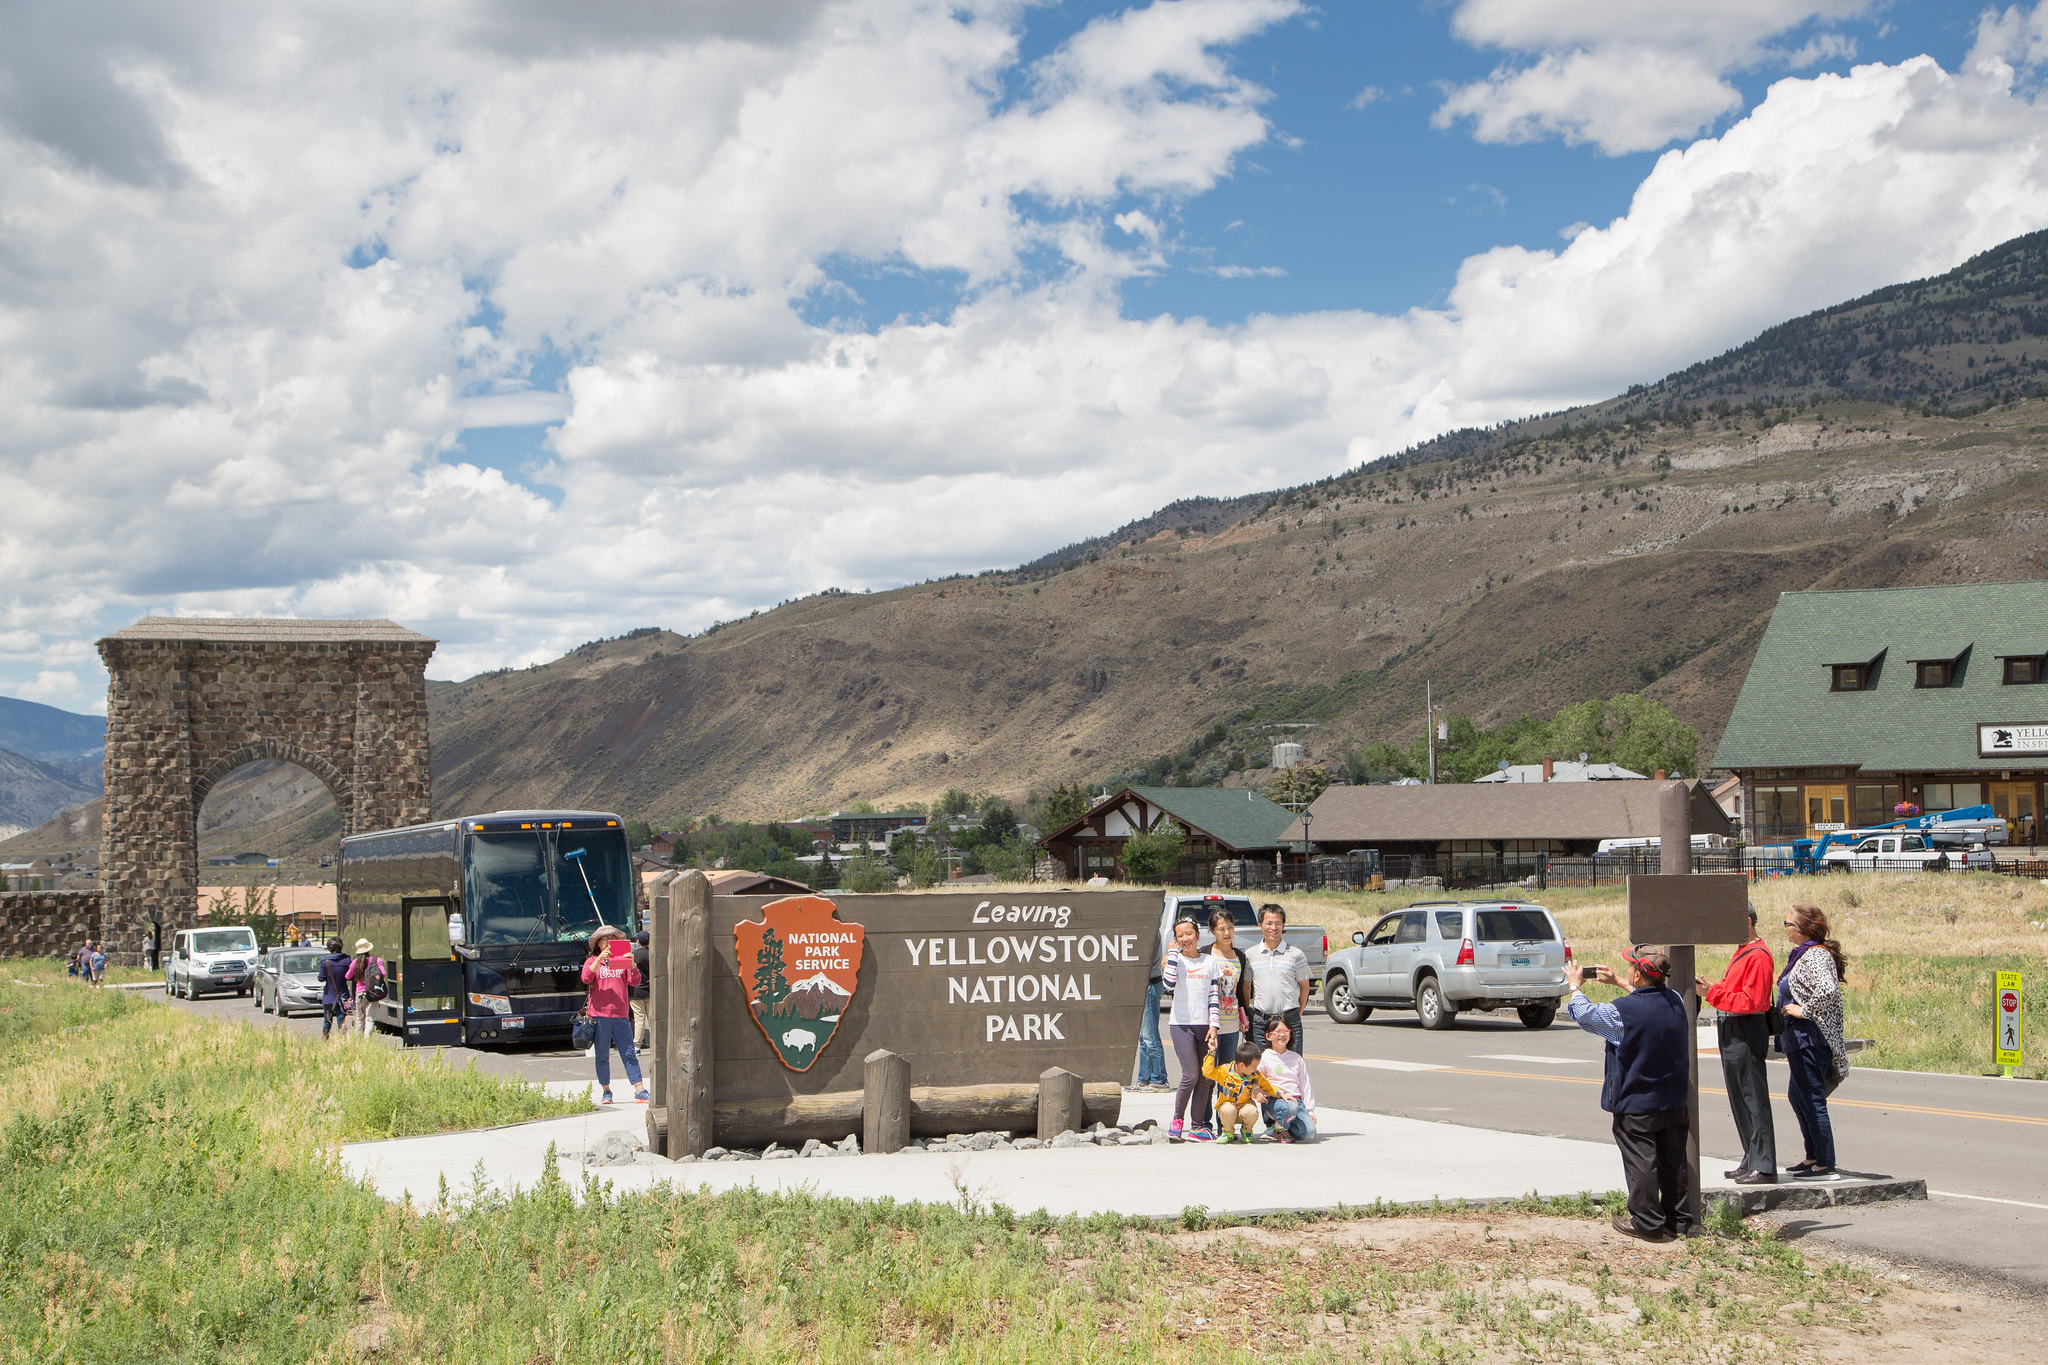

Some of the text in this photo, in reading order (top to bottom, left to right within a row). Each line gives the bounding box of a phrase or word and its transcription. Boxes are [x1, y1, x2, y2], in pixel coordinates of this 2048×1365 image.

[1920, 814, 1942, 828] S-65
[972, 901, 1071, 928] Leaving
[788, 932, 857, 944] NATIONAL
[804, 945, 840, 957] PARK
[904, 935, 1139, 965] YELLOWSTONE
[795, 958, 850, 970] SERVICE
[948, 974, 1101, 1004] NATIONAL
[2002, 998, 2017, 1007] STOP
[986, 1013, 1065, 1042] PARK
